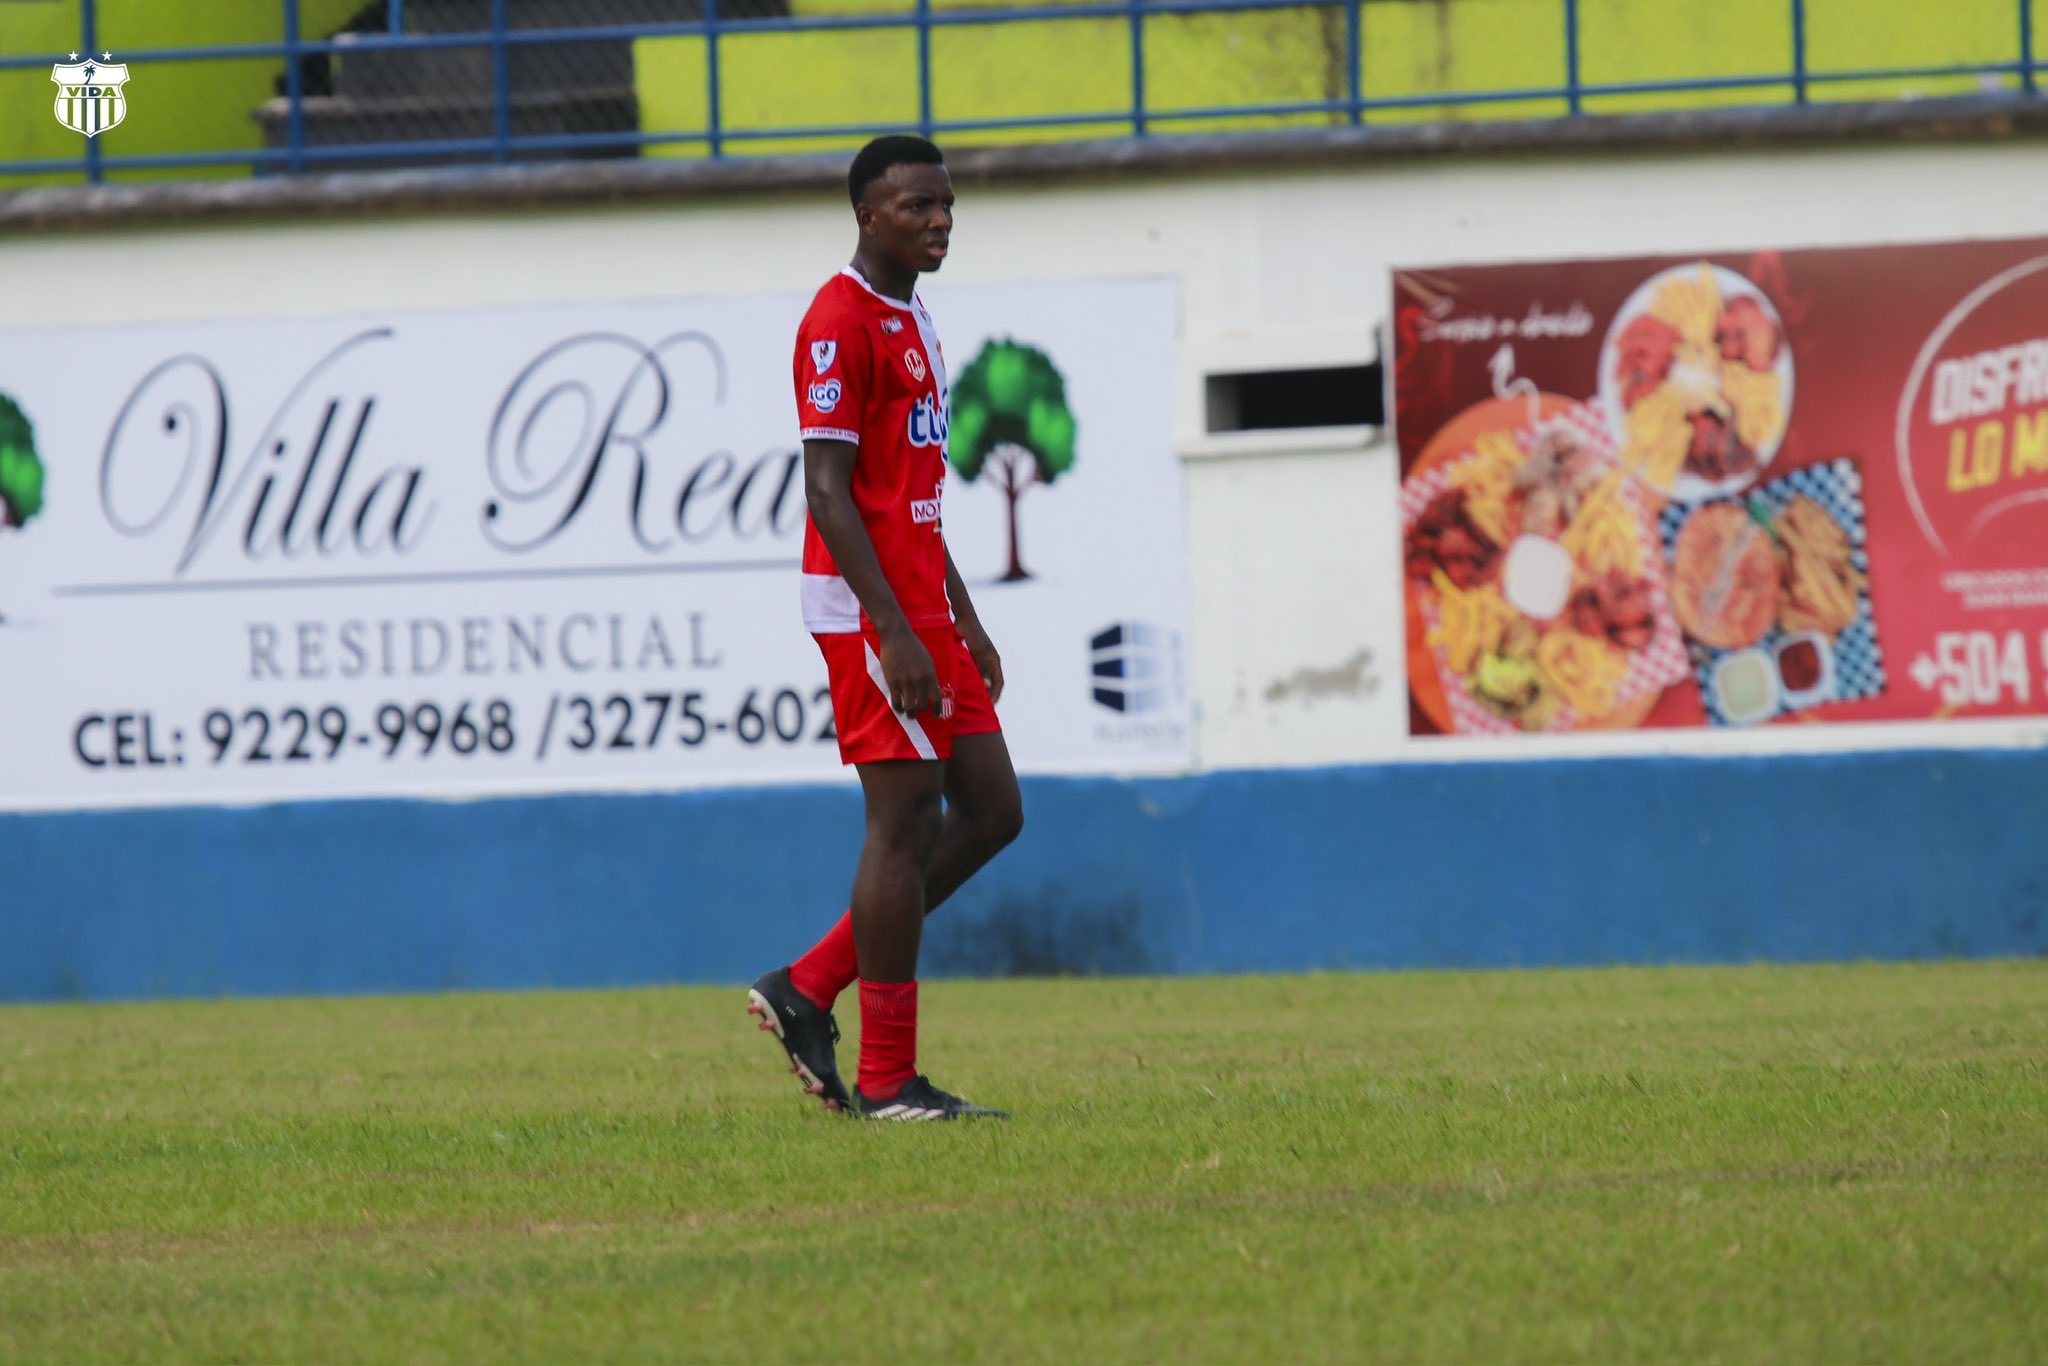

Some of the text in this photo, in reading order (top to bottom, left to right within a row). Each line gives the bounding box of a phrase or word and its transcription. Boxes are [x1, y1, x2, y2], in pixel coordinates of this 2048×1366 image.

[97, 327, 805, 578] Villa Rea
[1946, 419, 2005, 492] LO
[246, 611, 723, 681] RESIDENCIAL
[1908, 629, 2032, 705] +504
[73, 686, 838, 768] CEL: 9229-9968 /3275-602
